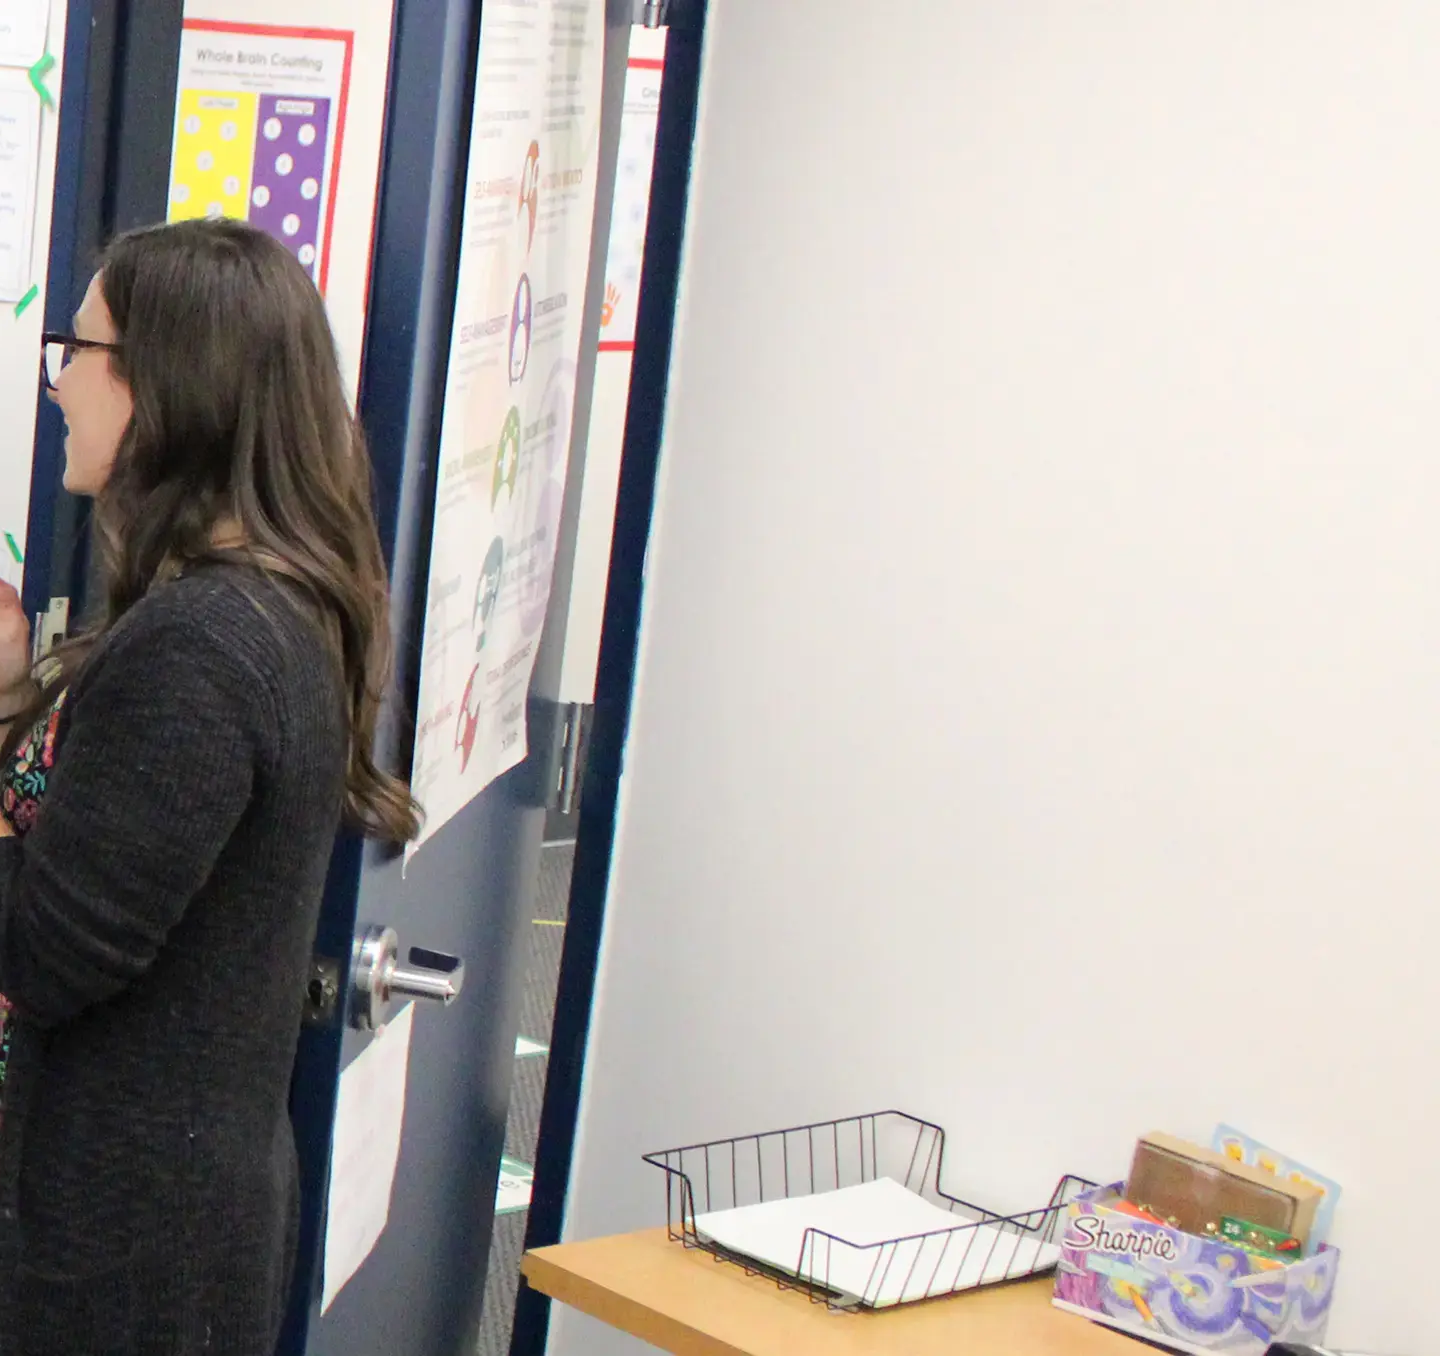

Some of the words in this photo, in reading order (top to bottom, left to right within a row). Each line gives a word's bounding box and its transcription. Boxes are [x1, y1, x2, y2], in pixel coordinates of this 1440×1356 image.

[196, 48, 234, 63] Whole
[237, 50, 267, 65] Brain
[270, 52, 323, 72] Counting
[1064, 1215, 1177, 1261] Sharpie
